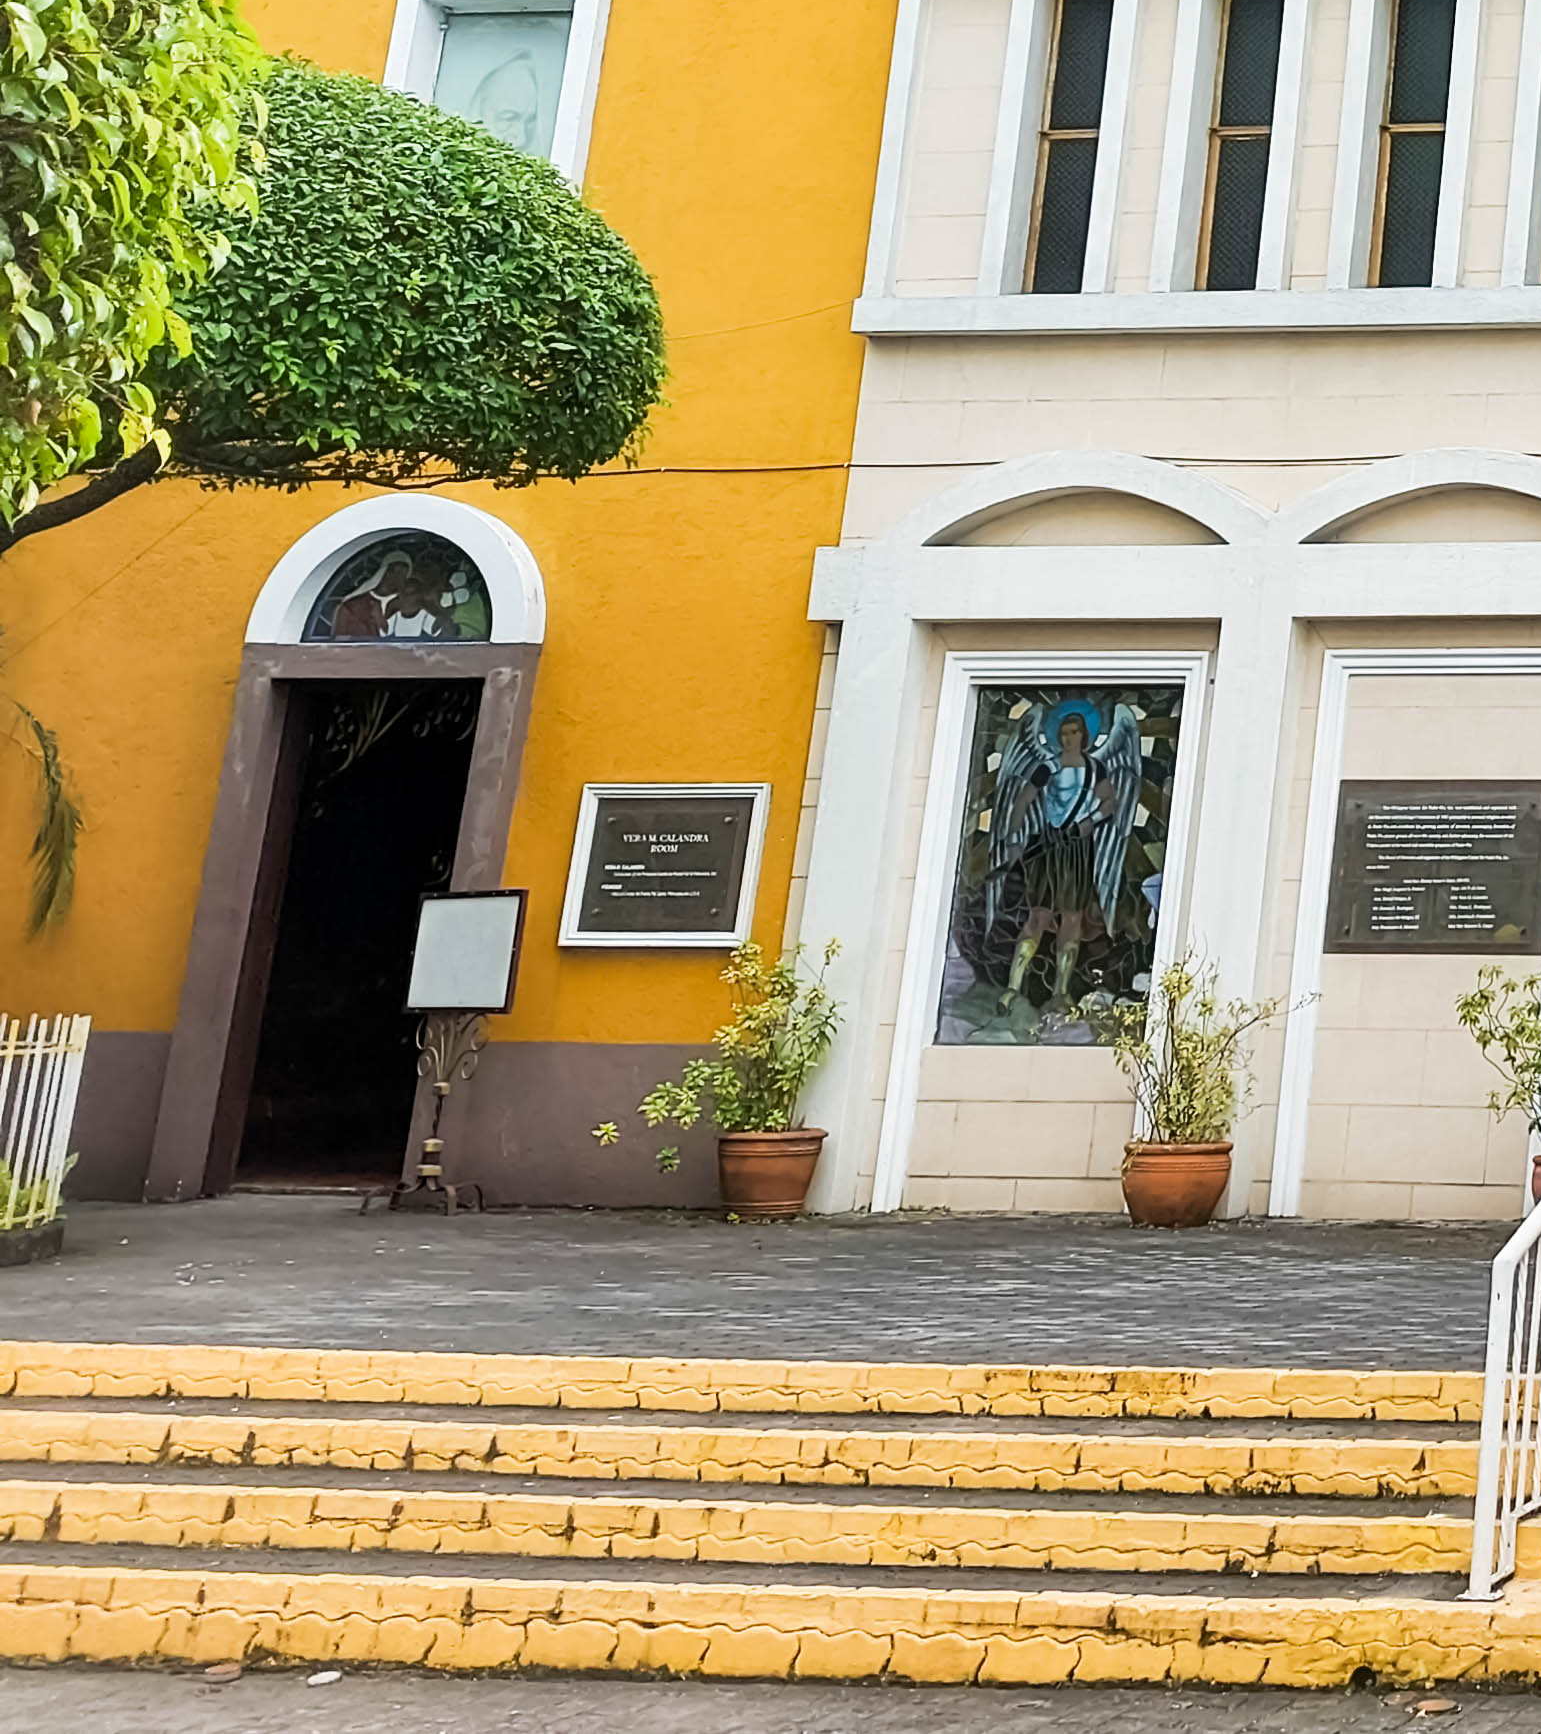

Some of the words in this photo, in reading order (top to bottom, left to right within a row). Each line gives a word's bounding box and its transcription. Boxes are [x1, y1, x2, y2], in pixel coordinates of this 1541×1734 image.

[623, 834, 647, 843] VERA
[659, 834, 710, 843] CALANDRA
[650, 844, 679, 853] ROOM
